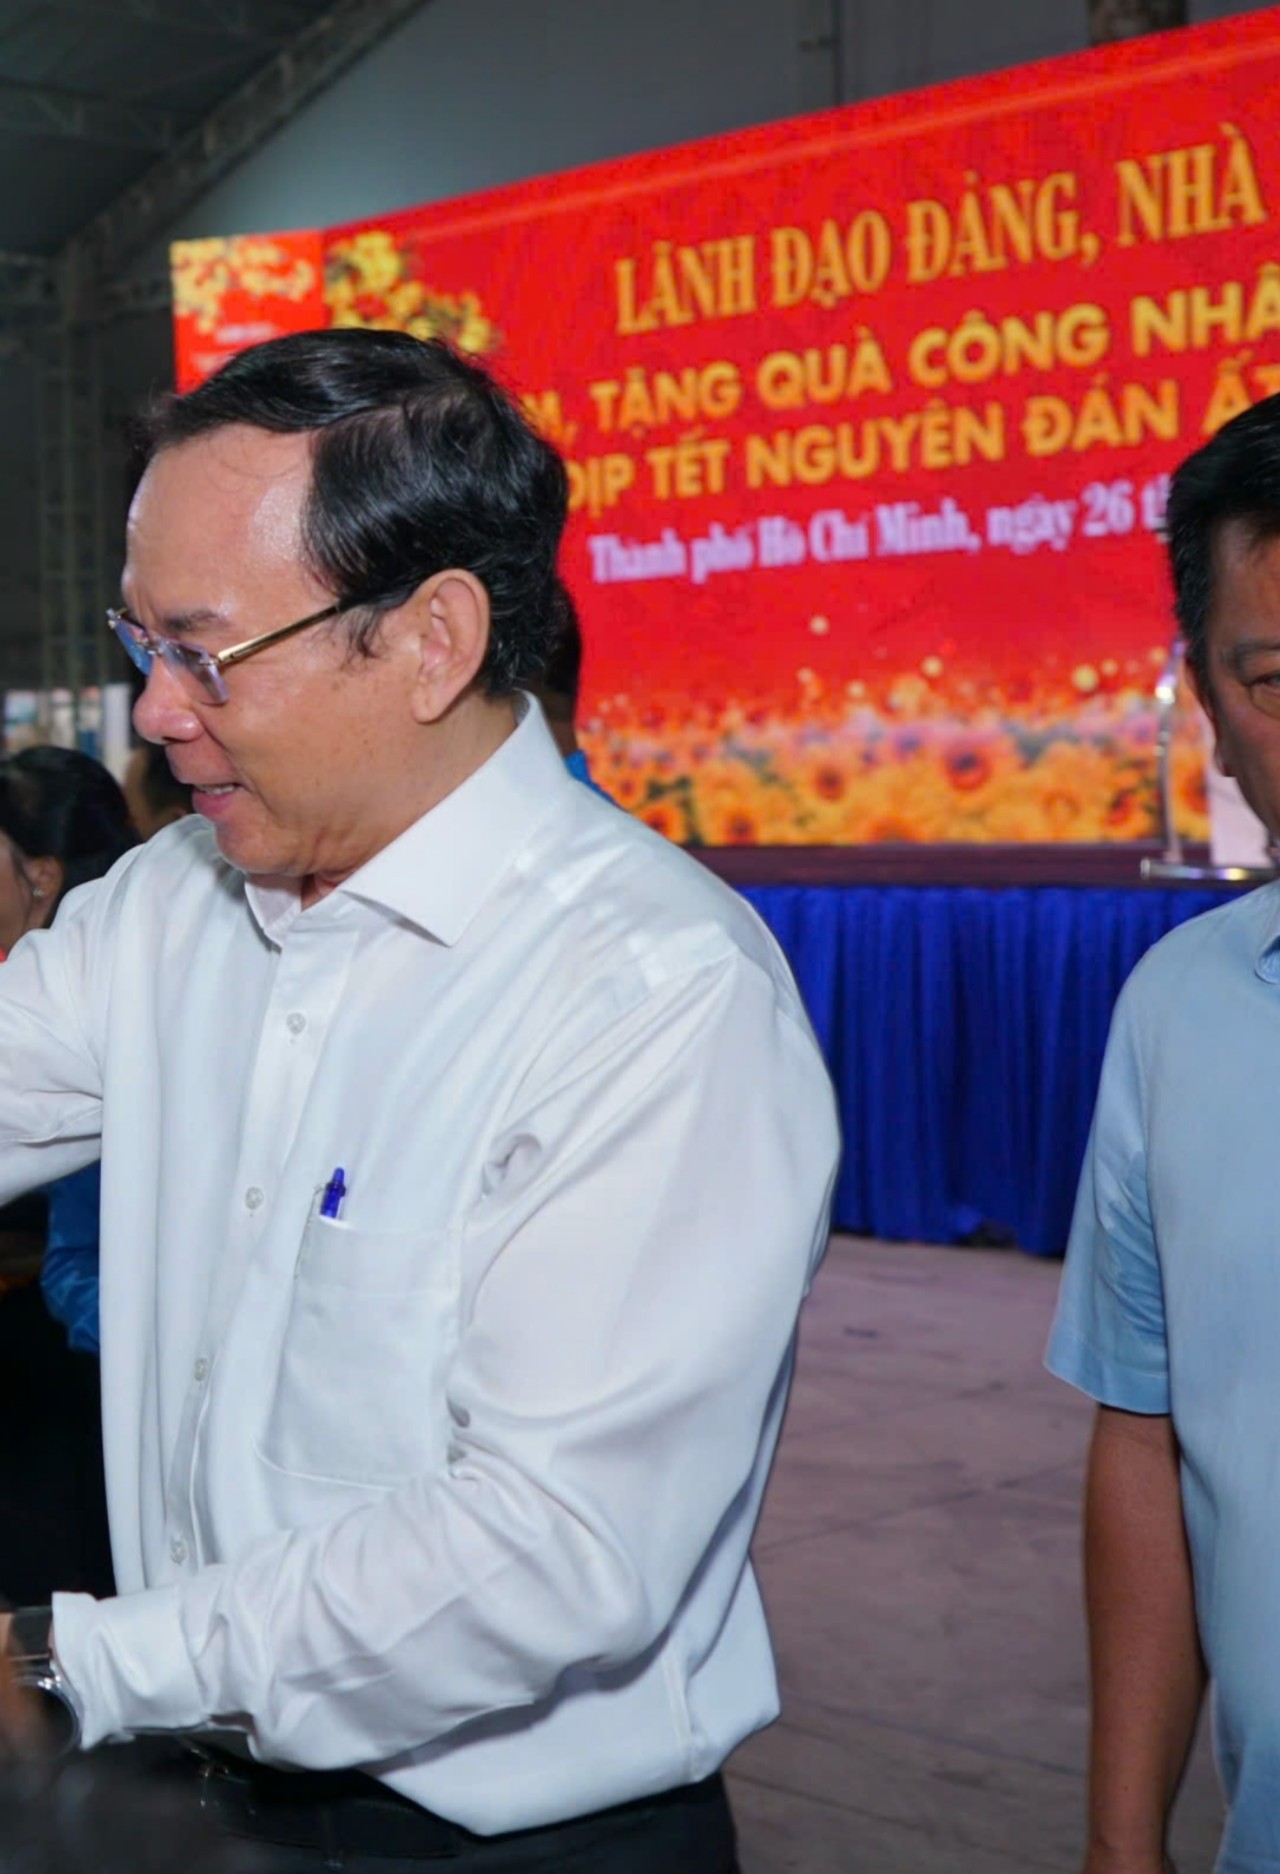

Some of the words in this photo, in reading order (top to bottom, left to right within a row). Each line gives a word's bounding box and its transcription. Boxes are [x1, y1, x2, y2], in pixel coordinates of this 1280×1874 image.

[771, 209, 892, 307] ĐẠO
[907, 169, 1099, 284] ĐẢNG,
[1116, 121, 1268, 247] NHÀ
[589, 360, 741, 439] TẶNG
[757, 324, 892, 410] QUÀ
[909, 303, 1109, 388] CÔNG
[646, 424, 730, 499] TẾT
[745, 399, 1005, 489] NGUYÊN
[1023, 371, 1178, 456] ĐÁN
[1080, 479, 1134, 537] 26
